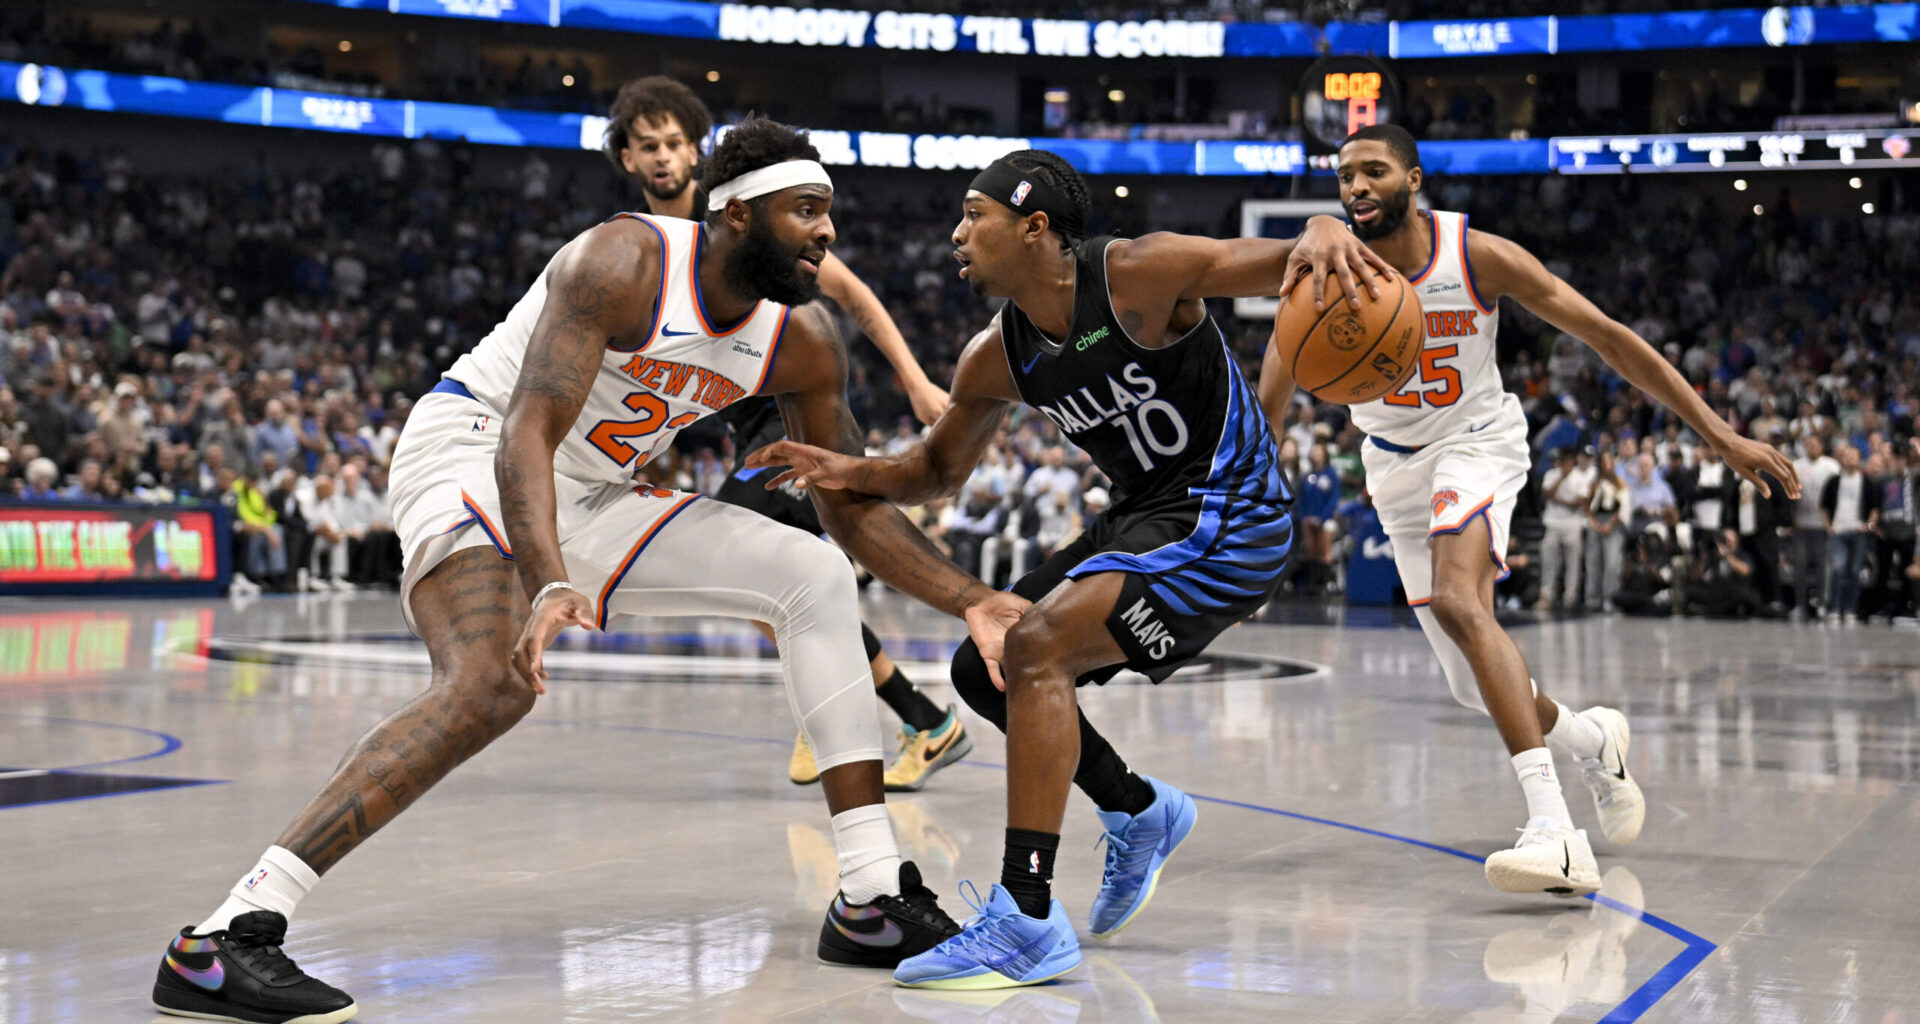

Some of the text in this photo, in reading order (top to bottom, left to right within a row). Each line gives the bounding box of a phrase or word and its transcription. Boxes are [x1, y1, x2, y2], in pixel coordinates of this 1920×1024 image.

[719, 3, 1225, 58] NOBODY SITS 'TIL WE SCORE!
[1075, 325, 1110, 351] chime
[1424, 310, 1479, 339] ORK
[620, 353, 748, 411] NEW YORK
[1038, 361, 1157, 435] DALLAS
[1110, 398, 1189, 472] 10
[1120, 596, 1176, 660] MAVS
